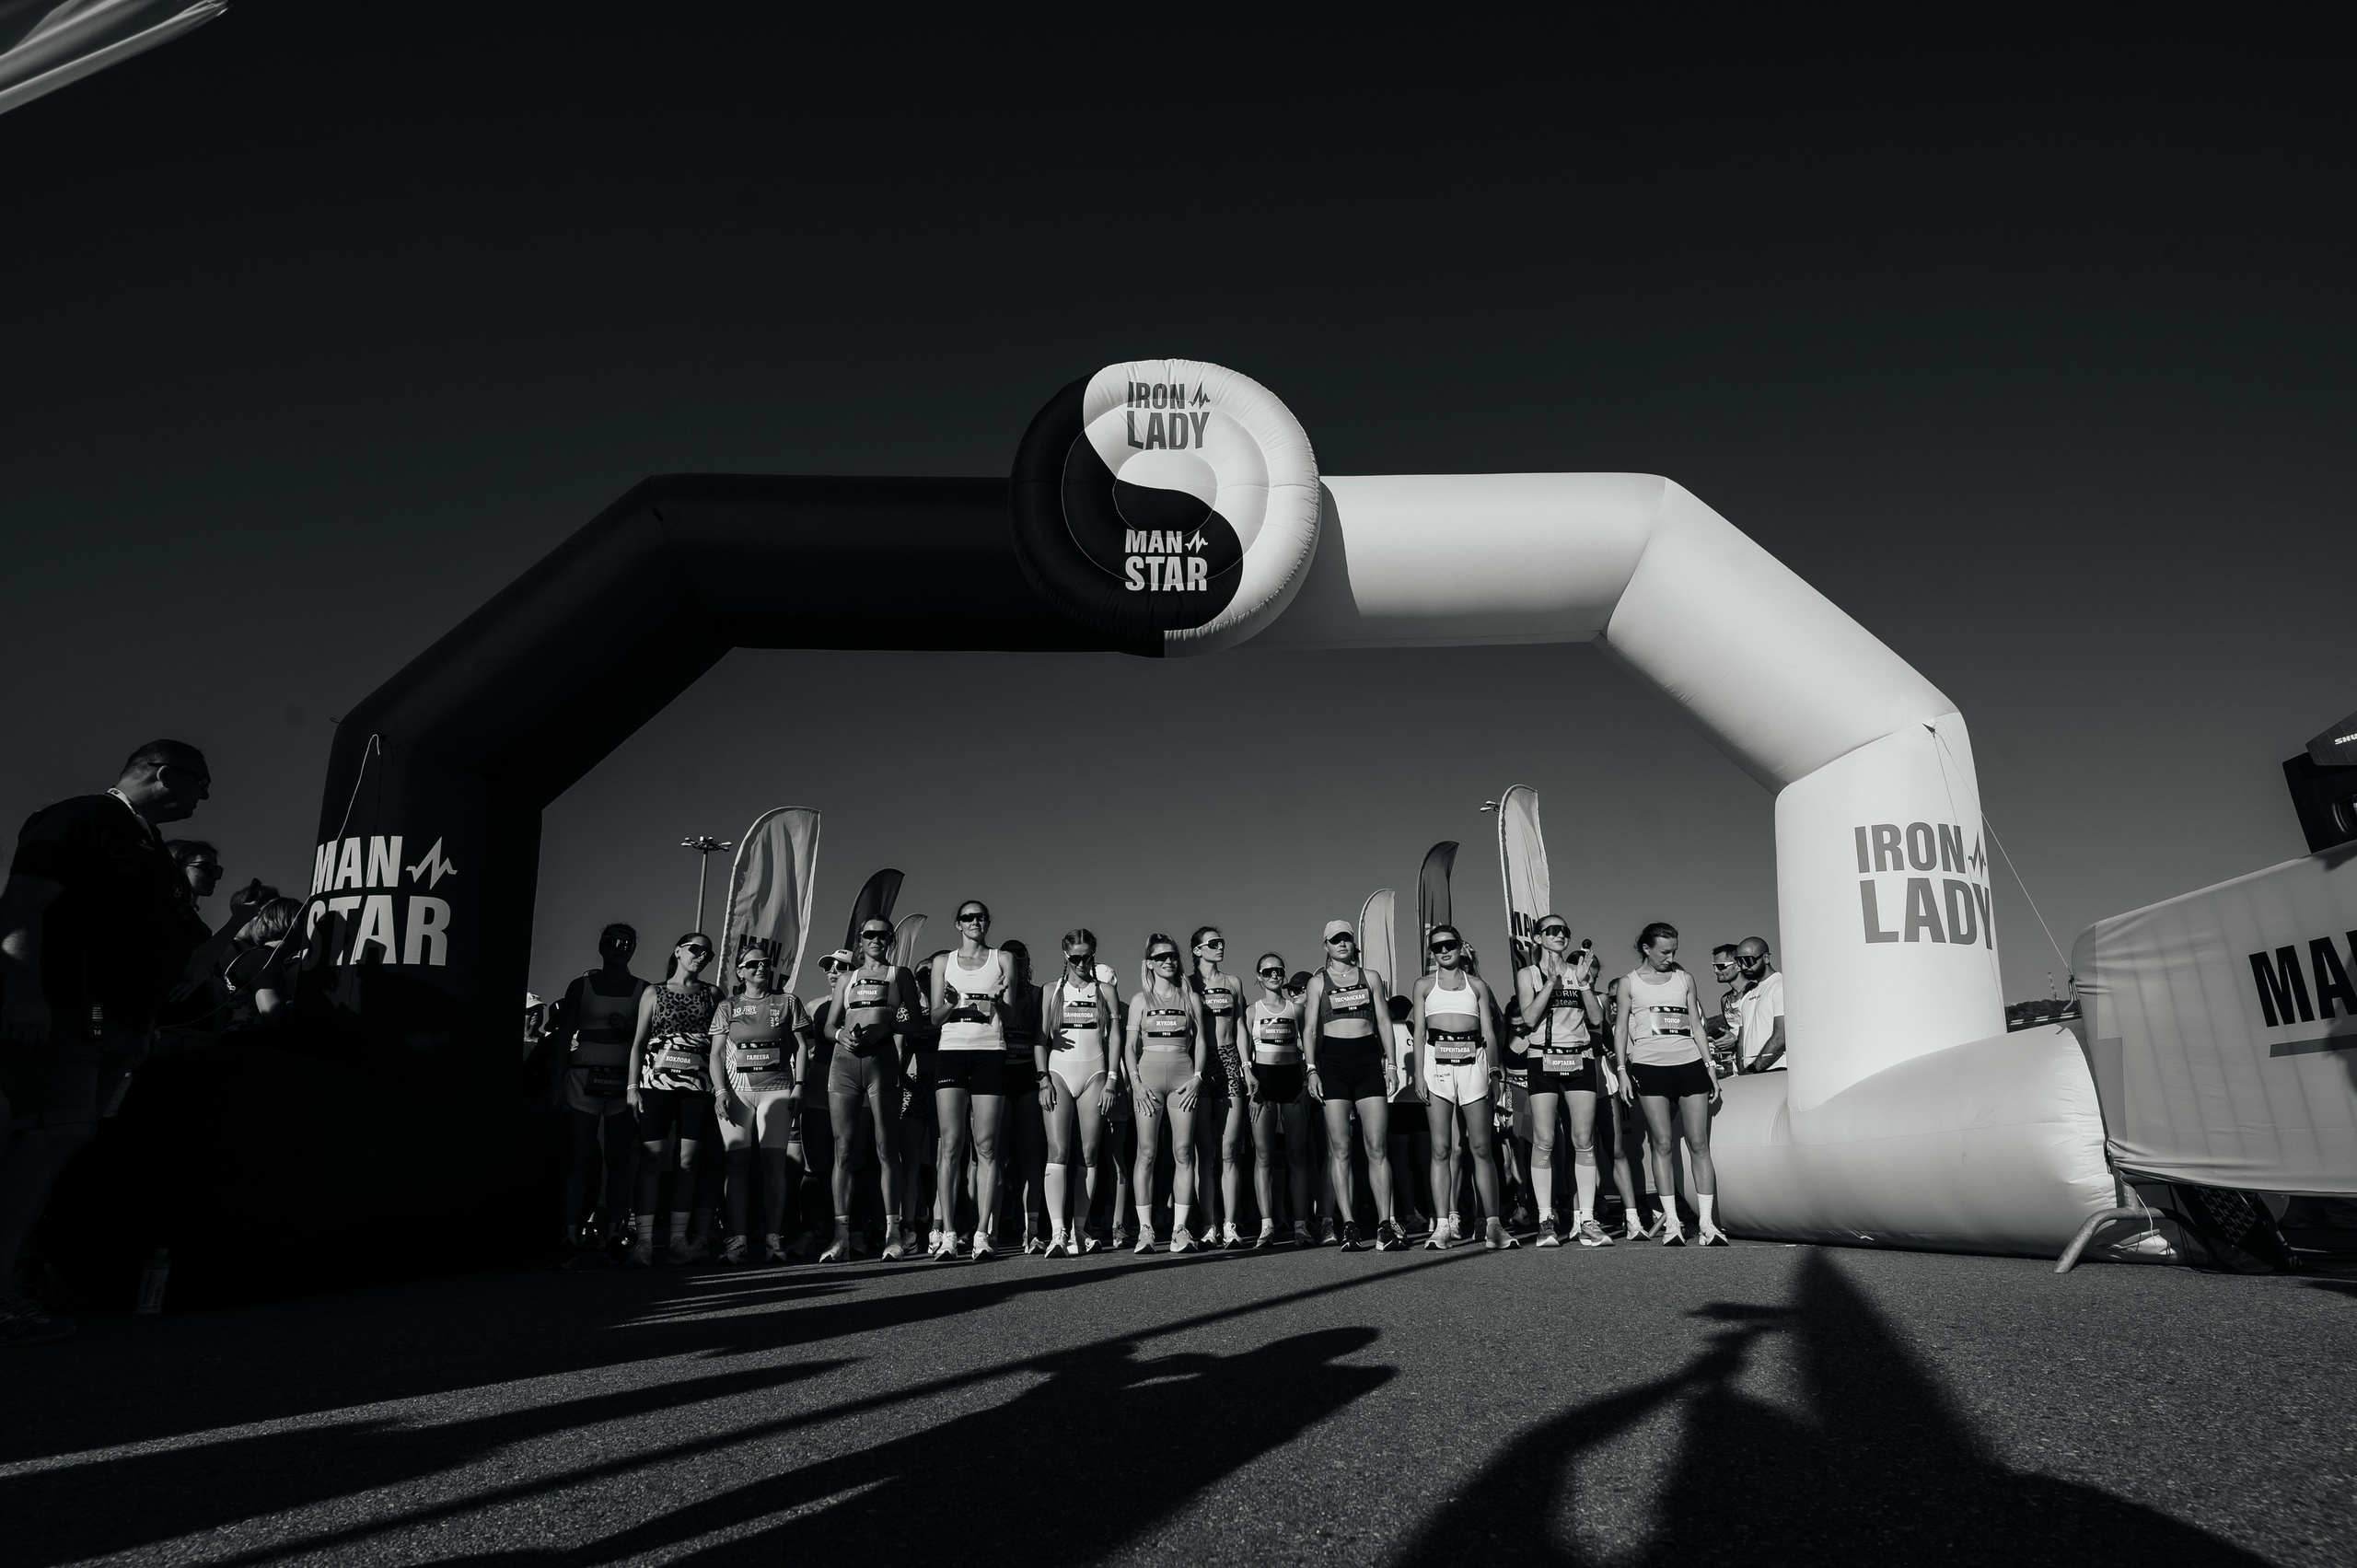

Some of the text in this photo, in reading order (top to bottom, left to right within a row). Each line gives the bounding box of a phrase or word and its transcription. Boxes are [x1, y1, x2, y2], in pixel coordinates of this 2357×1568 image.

[1127, 381, 1185, 409] IRON
[1127, 411, 1211, 450] LADY
[1125, 528, 1182, 553] MAN
[1125, 555, 1207, 591] STAR
[310, 835, 403, 897] MAN
[1854, 821, 1966, 874] IRON
[1859, 877, 1992, 950] LADY
[301, 894, 452, 971] STAR
[1335, 994, 1365, 1004] ПЕСЧАНСКАЯ
[665, 1055, 691, 1064] ХОХЛОВА
